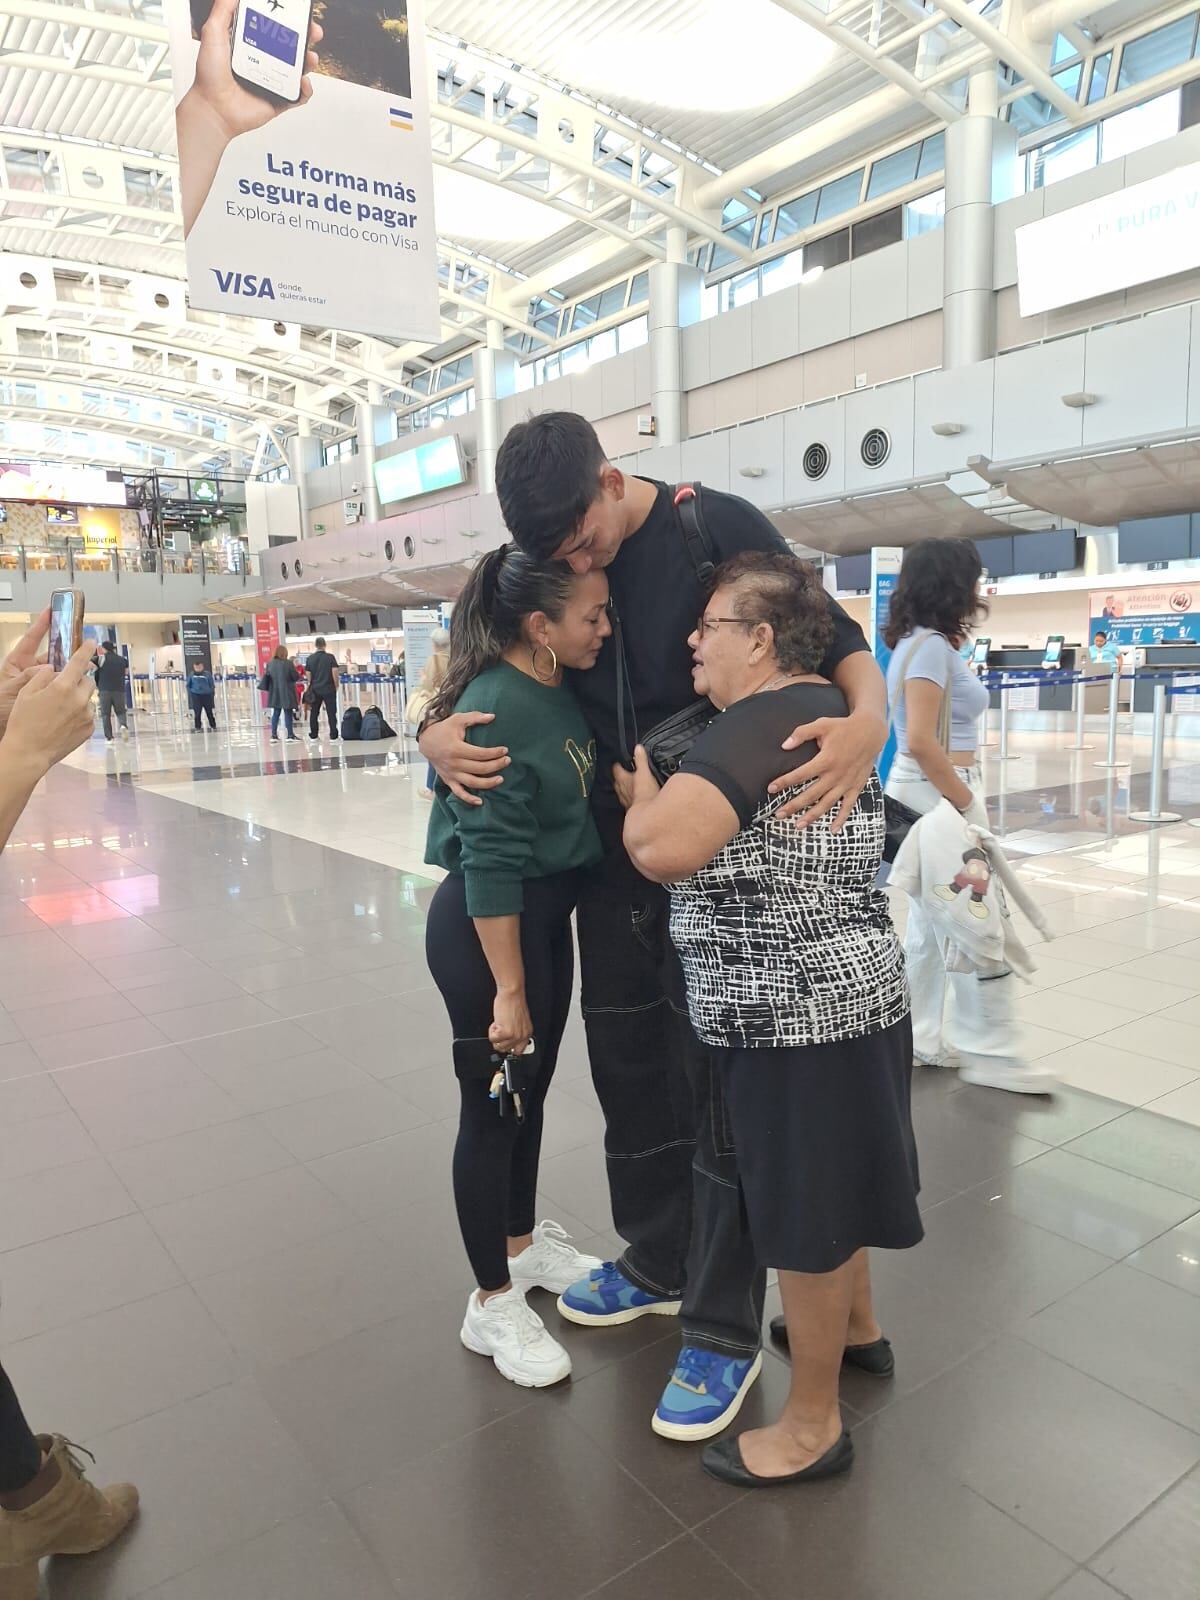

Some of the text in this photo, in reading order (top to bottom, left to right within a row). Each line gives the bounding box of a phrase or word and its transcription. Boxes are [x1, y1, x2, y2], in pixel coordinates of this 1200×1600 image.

[244, 35, 257, 47] VISA
[247, 55, 260, 65] VISA
[266, 152, 417, 204] La forma más
[237, 178, 418, 229] segura de pagar
[225, 200, 419, 251] Explorá el mundo con Visa
[208, 268, 276, 300] VISA
[277, 282, 302, 292] donde
[279, 292, 327, 305] quieras estar
[86, 534, 118, 545] Imperial
